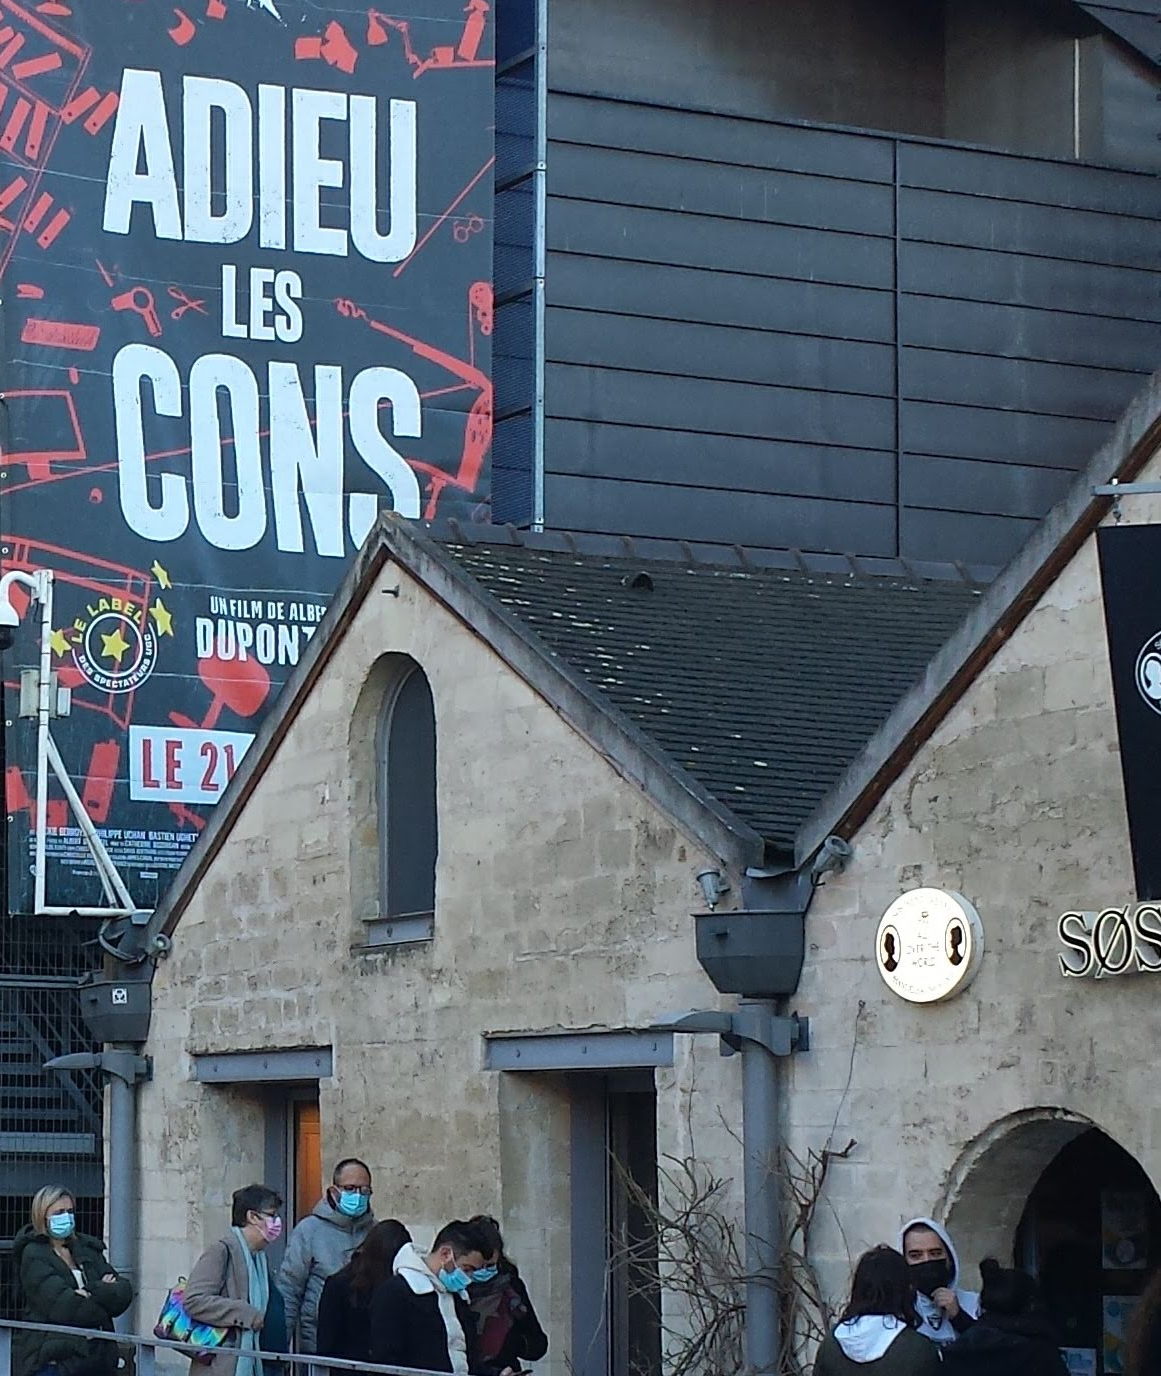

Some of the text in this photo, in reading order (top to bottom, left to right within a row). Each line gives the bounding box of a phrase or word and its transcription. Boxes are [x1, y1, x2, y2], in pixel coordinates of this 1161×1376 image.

[102, 67, 417, 264] ADIEU
[221, 264, 304, 343] LES
[112, 343, 422, 558] CONS
[71, 597, 143, 644] LE LABEL
[210, 595, 228, 616] UN
[229, 599, 263, 619] FILM
[267, 601, 285, 620] DE
[142, 738, 183, 790] LE
